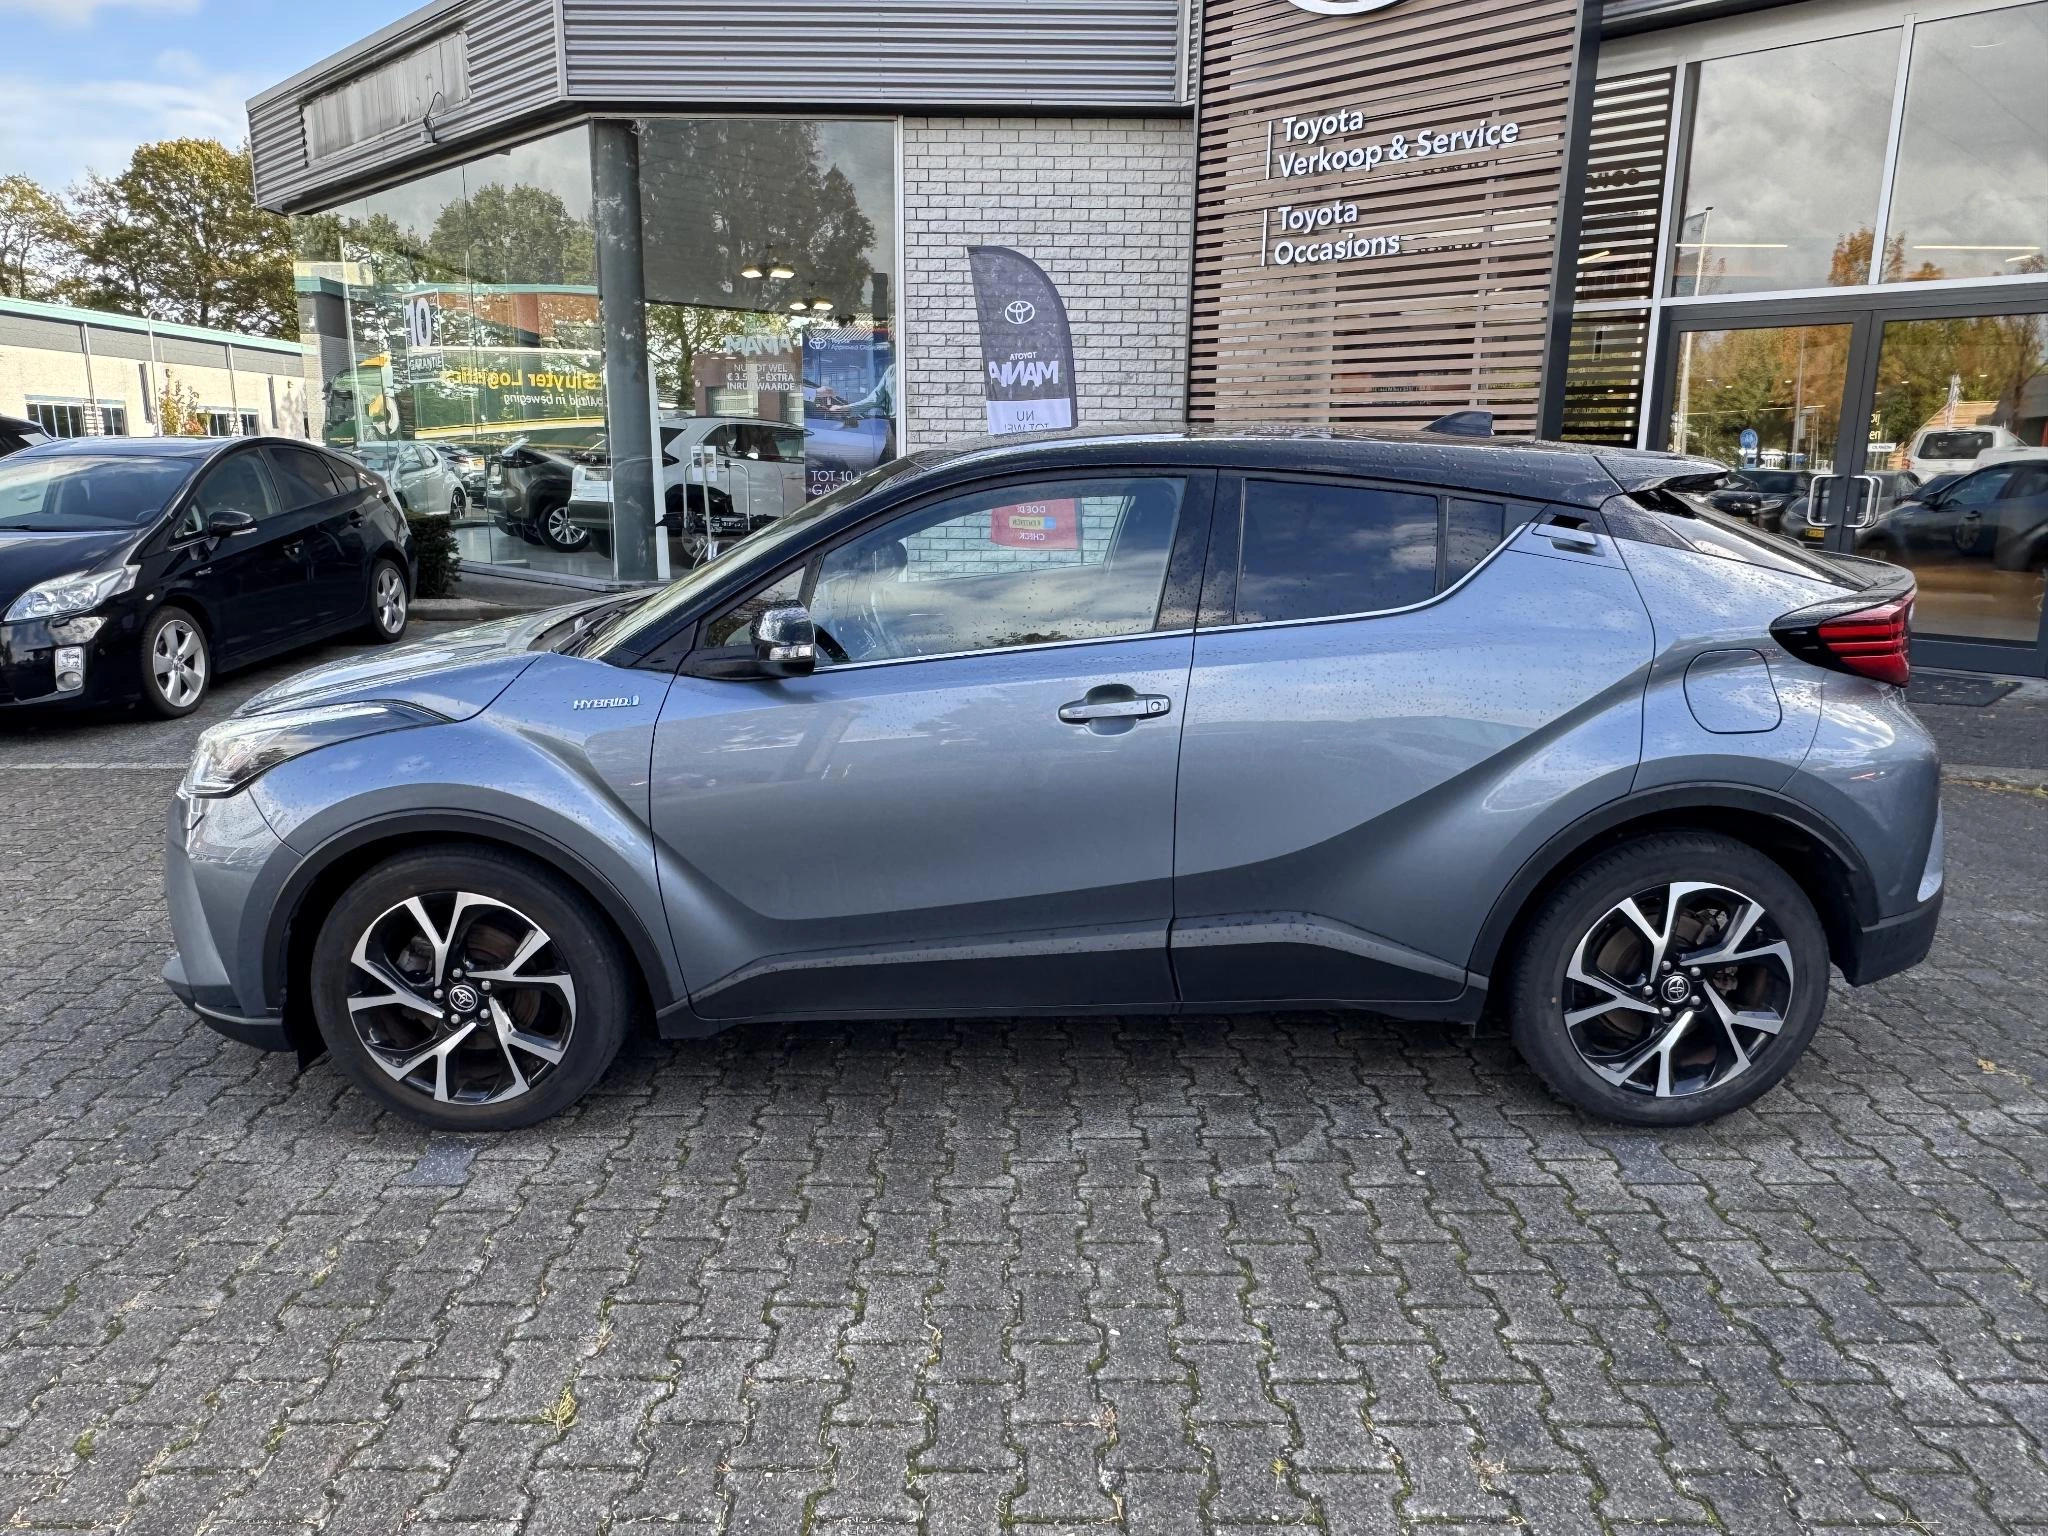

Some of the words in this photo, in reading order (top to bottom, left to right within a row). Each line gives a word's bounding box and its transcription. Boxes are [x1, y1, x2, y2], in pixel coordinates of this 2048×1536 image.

[1282, 109, 1364, 144] Toyota
[1279, 146, 1382, 178] Verkoop
[1388, 134, 1408, 161] &
[1417, 120, 1519, 157] Service
[1278, 200, 1358, 234] Toyota
[1274, 233, 1400, 265] Occasions
[811, 471, 836, 481] TOT
[573, 698, 629, 710] HYBRID
